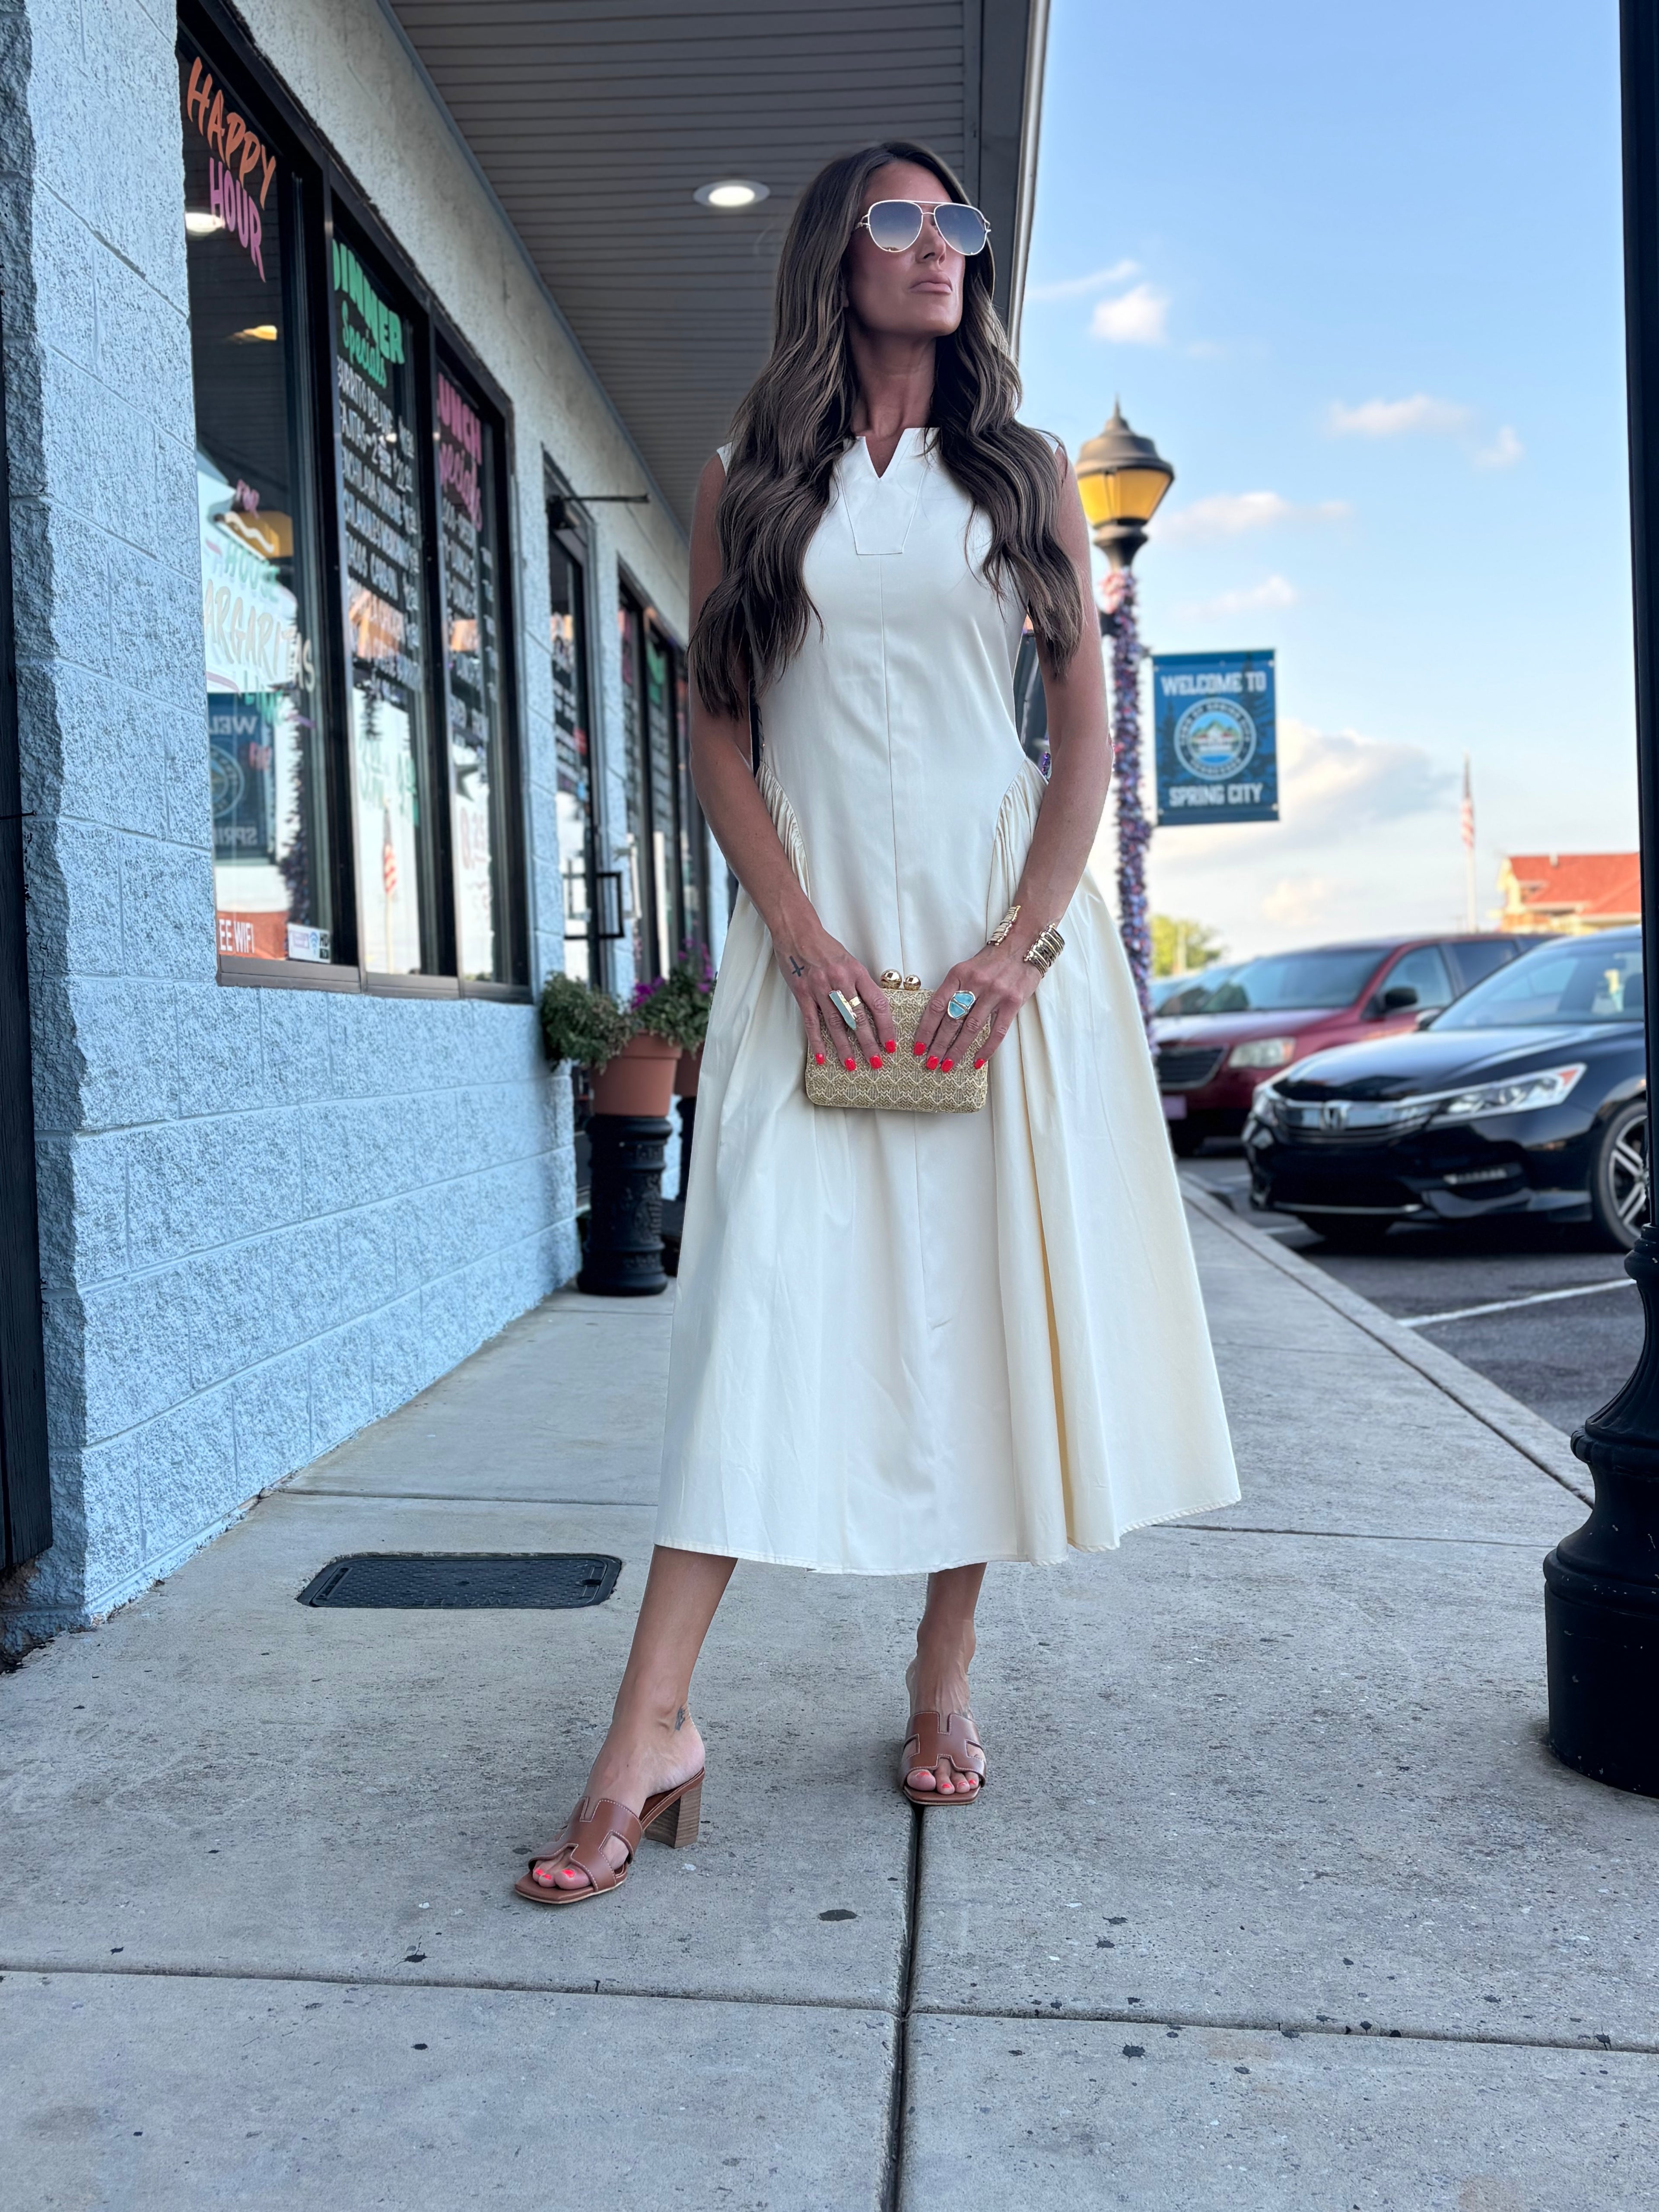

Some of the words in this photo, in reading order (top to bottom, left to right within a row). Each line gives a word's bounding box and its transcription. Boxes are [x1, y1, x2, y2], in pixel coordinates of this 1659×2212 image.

[187, 57, 276, 210] HAPPY
[210, 158, 265, 283] HOUR
[332, 238, 405, 364] DINNER
[437, 372, 482, 465] UNCH
[204, 579, 315, 692] ARGARITAS
[1161, 672, 1243, 696] WELCOME
[1246, 671, 1267, 691] TO
[1170, 785, 1225, 806] SPRING
[1227, 782, 1263, 804] CITY
[219, 919, 232, 951] EE
[234, 920, 254, 954] WIFI
